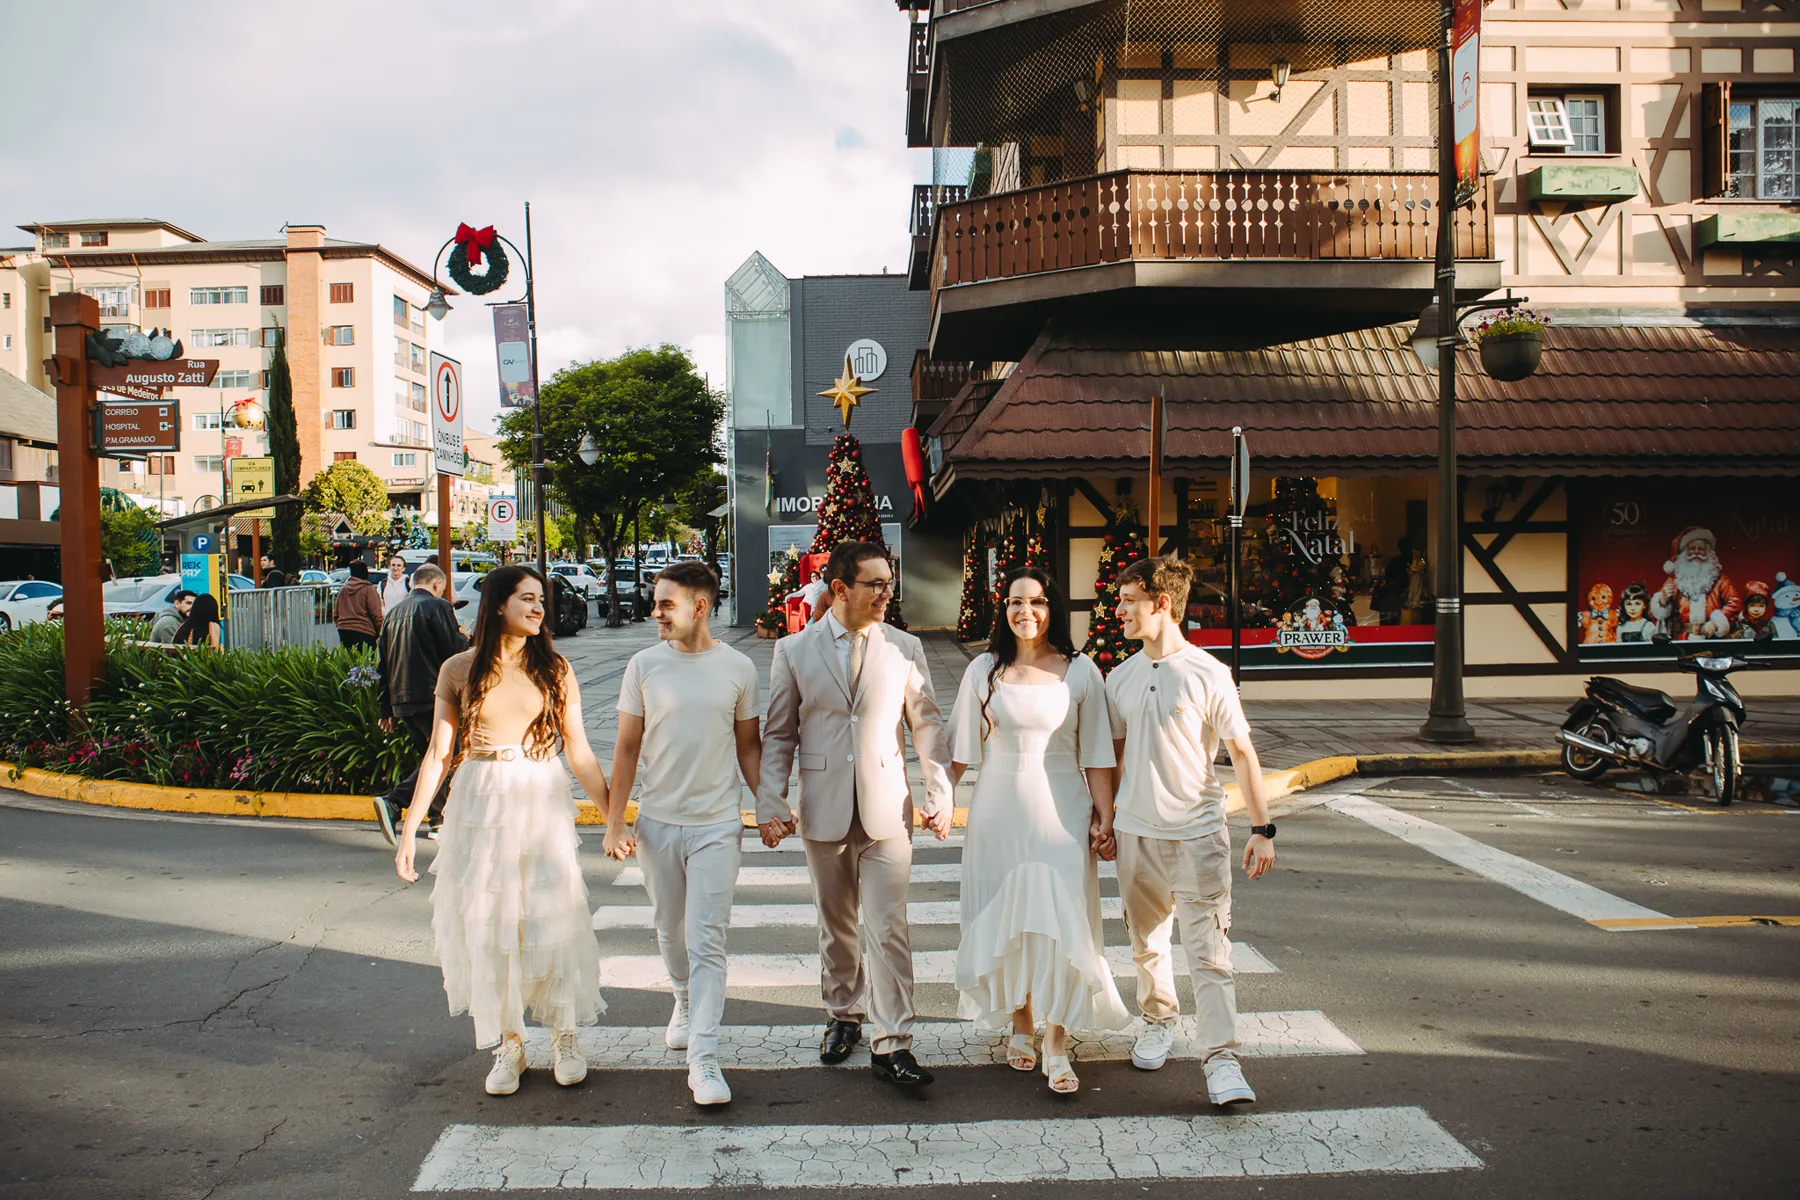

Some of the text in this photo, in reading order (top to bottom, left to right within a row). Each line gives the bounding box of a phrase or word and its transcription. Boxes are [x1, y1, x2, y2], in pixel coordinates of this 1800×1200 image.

[187, 360, 206, 369] Rua
[125, 372, 205, 385] Augusto Zatti
[127, 385, 159, 400] Medeiros
[105, 408, 139, 416] CORREIO
[437, 427, 461, 448] ÔNIBUS E
[436, 447, 463, 465] CAMINHÕES
[498, 505, 507, 518] E
[1611, 501, 1639, 525] 50
[1287, 510, 1342, 531] Feliz
[197, 537, 208, 549] P
[1277, 528, 1356, 565] Natal
[182, 569, 202, 577] PAY
[1284, 632, 1341, 644] PRAWER
